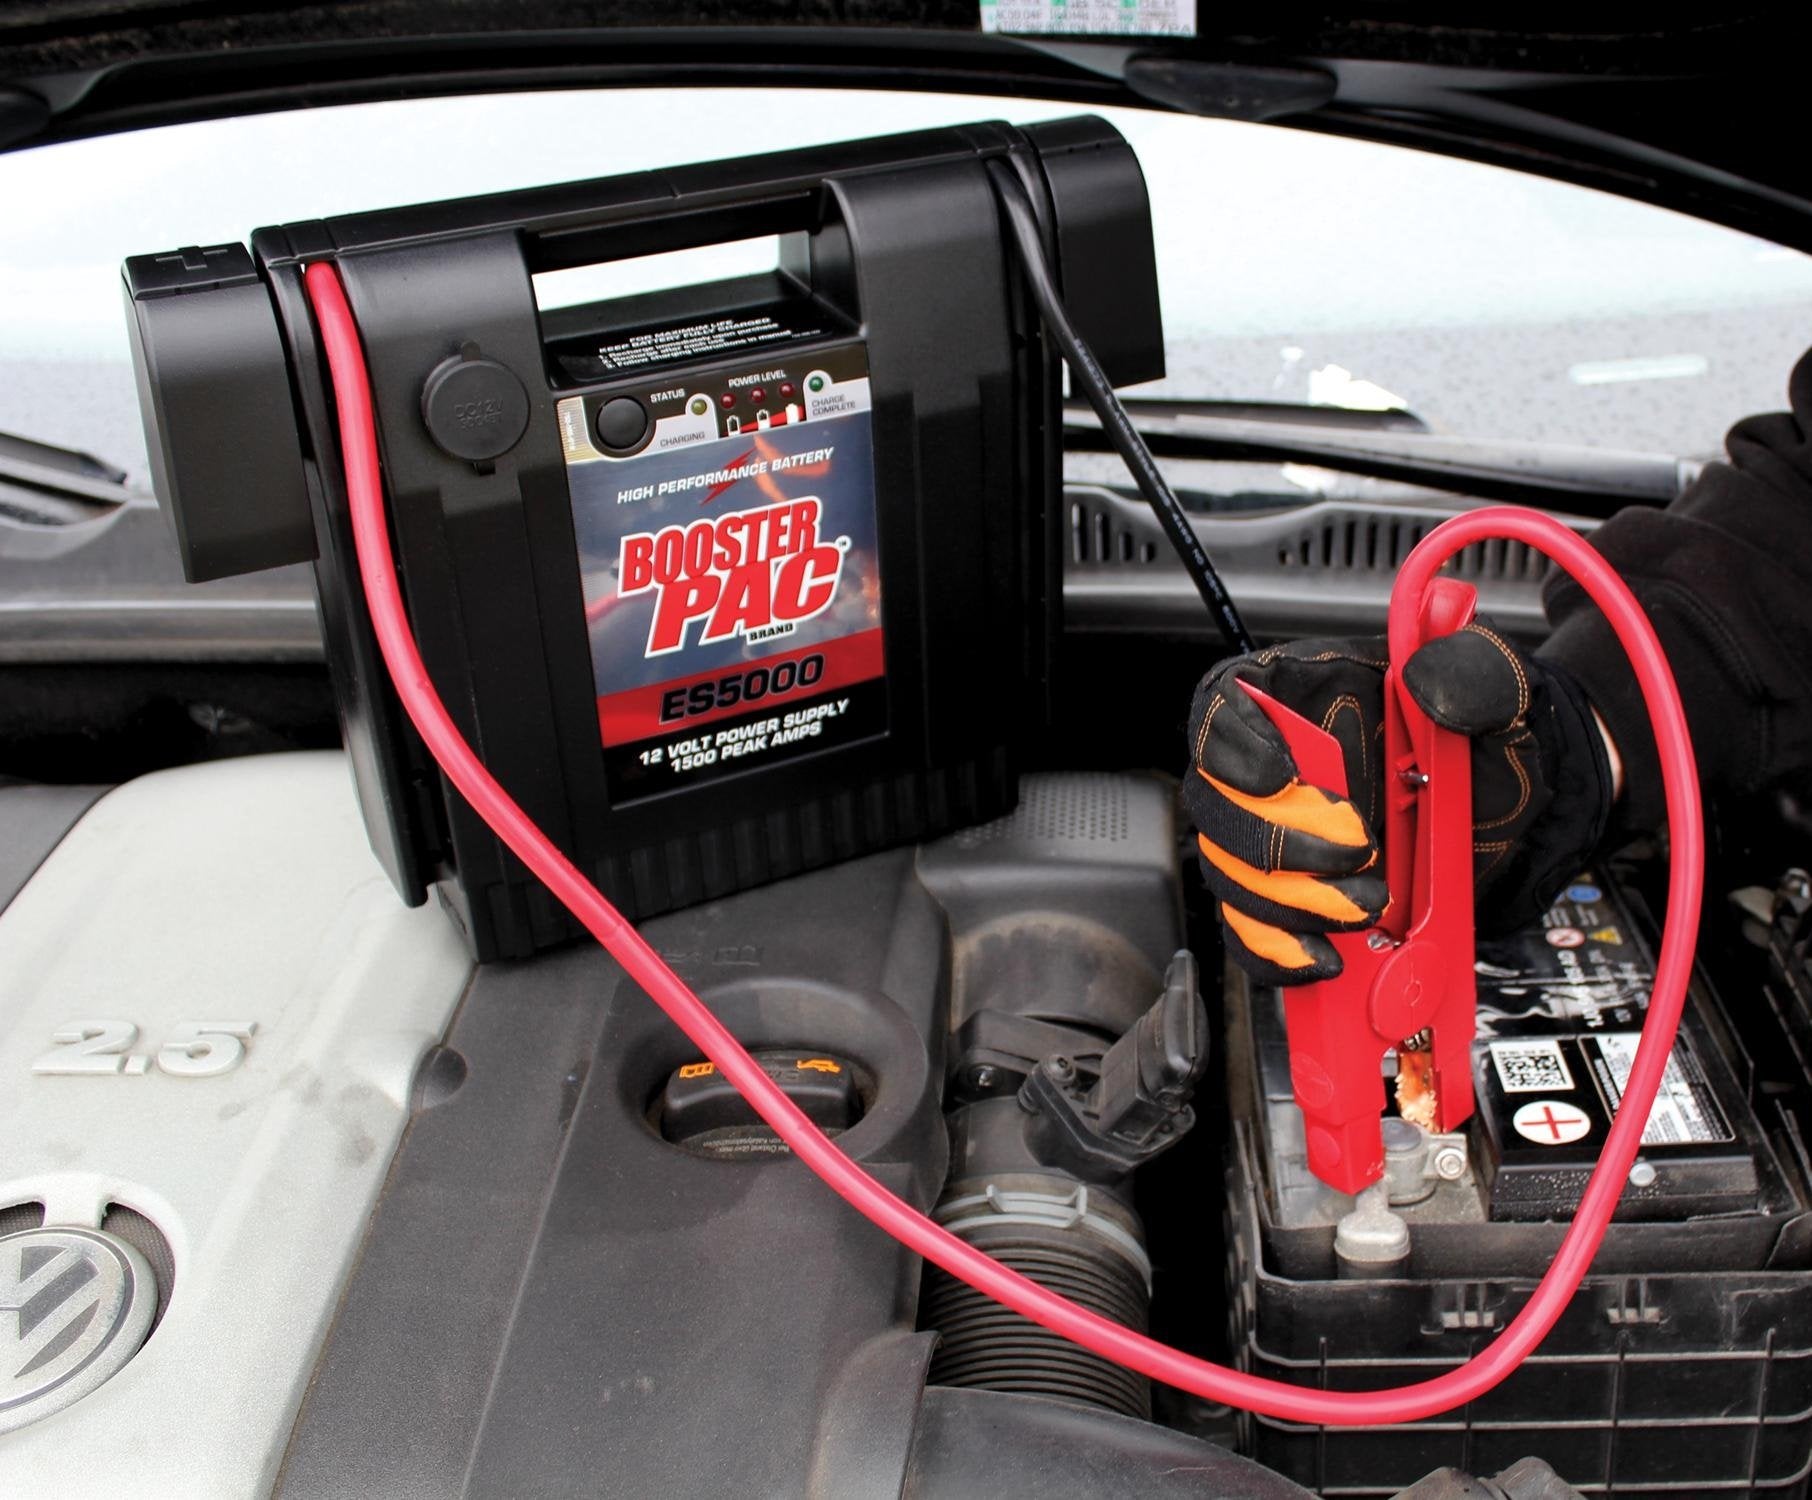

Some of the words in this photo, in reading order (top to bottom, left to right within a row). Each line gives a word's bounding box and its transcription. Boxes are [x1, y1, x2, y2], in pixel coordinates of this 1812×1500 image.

[599, 343, 631, 354] KEEP
[631, 334, 681, 348] BATTERY
[682, 327, 718, 339] FULLY
[717, 317, 772, 332] CHARGED
[608, 346, 655, 358] Recharge
[655, 336, 711, 349] immediately
[712, 331, 737, 341] upon
[736, 322, 780, 335] purchase
[710, 319, 734, 330] LIFE
[612, 351, 659, 363] Recharge
[660, 346, 682, 354] after
[616, 357, 649, 368] Follow
[650, 350, 693, 361] charging
[692, 340, 748, 352] instructions
[728, 373, 761, 388] POWER
[761, 369, 786, 382] LEVEL
[650, 388, 685, 403] STATUS
[811, 394, 846, 408] CHARGE
[812, 401, 856, 416] COMPLETE
[660, 431, 706, 448] CHARGING
[616, 485, 654, 504] HIGH
[657, 462, 768, 497] PERFORMANCE
[771, 447, 834, 472] BATTERY
[620, 498, 820, 595] BOOSTER
[647, 543, 842, 656] PAC
[749, 622, 794, 642] BRAND
[659, 655, 825, 726] ES5000
[640, 749, 664, 766] 12
[668, 734, 712, 759] VOLT
[716, 717, 780, 746] POWER
[783, 698, 850, 729] SUPPLY
[671, 752, 718, 773] 1500
[721, 736, 767, 761] PEAK
[770, 721, 823, 746] AMPS
[32, 1019, 259, 1077] 2.5
